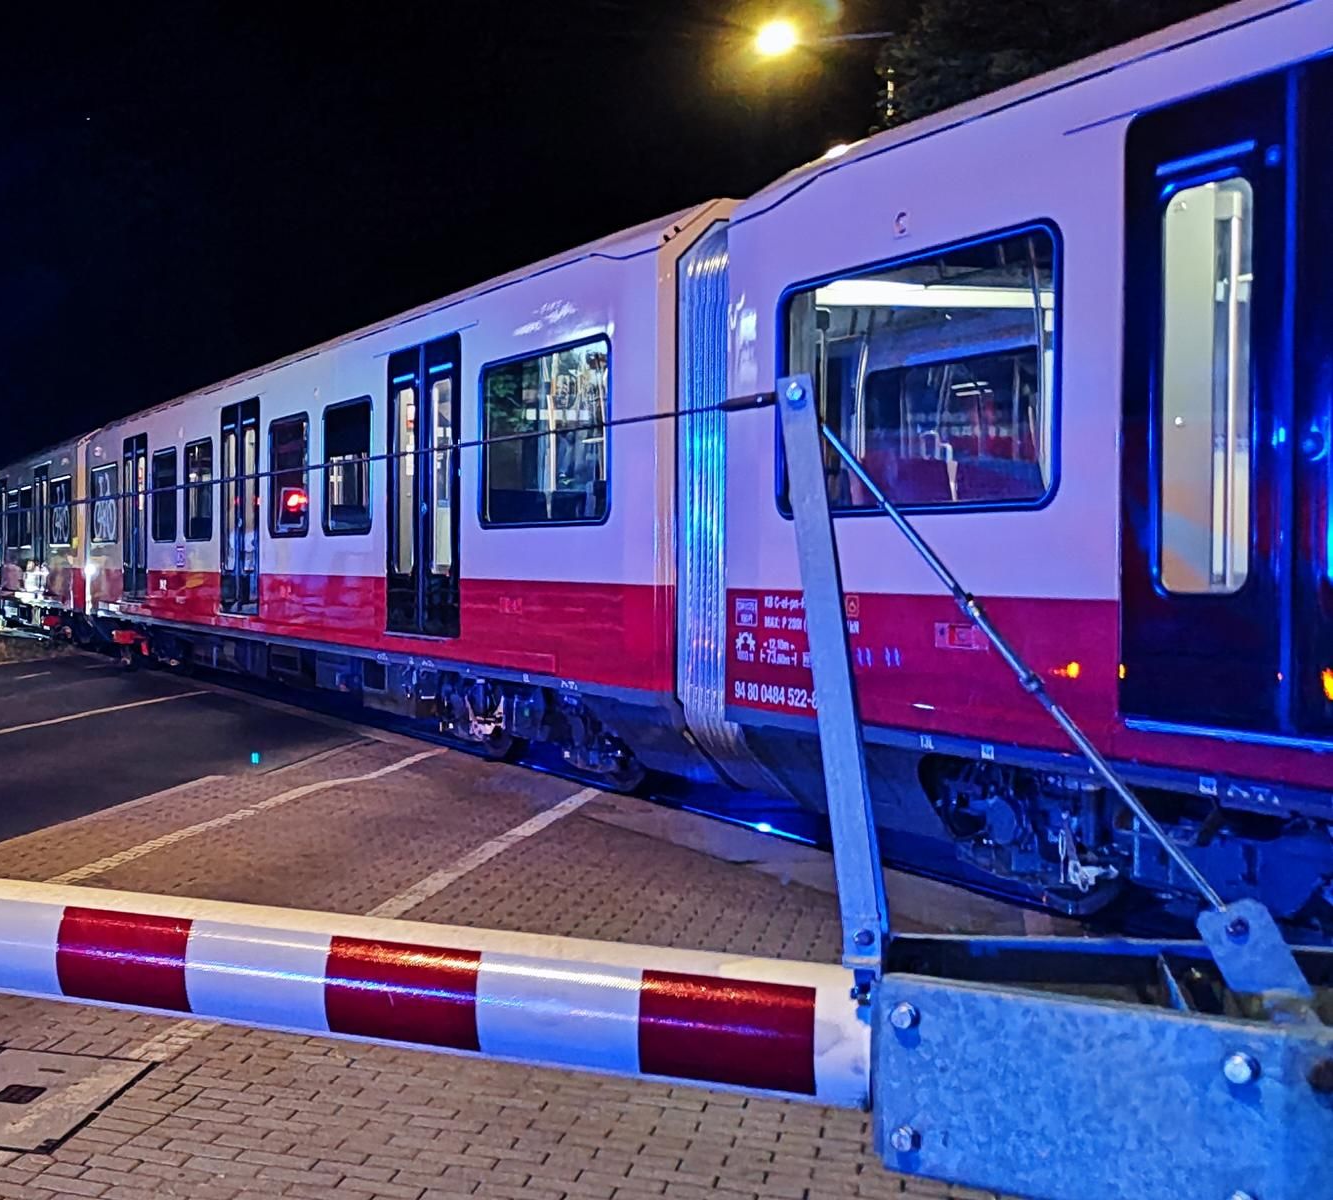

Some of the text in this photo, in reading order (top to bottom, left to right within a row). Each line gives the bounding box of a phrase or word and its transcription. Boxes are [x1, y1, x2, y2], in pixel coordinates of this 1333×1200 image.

[735, 681, 745, 699] 94
[747, 683, 759, 701] 80
[761, 684, 785, 705] 0484
